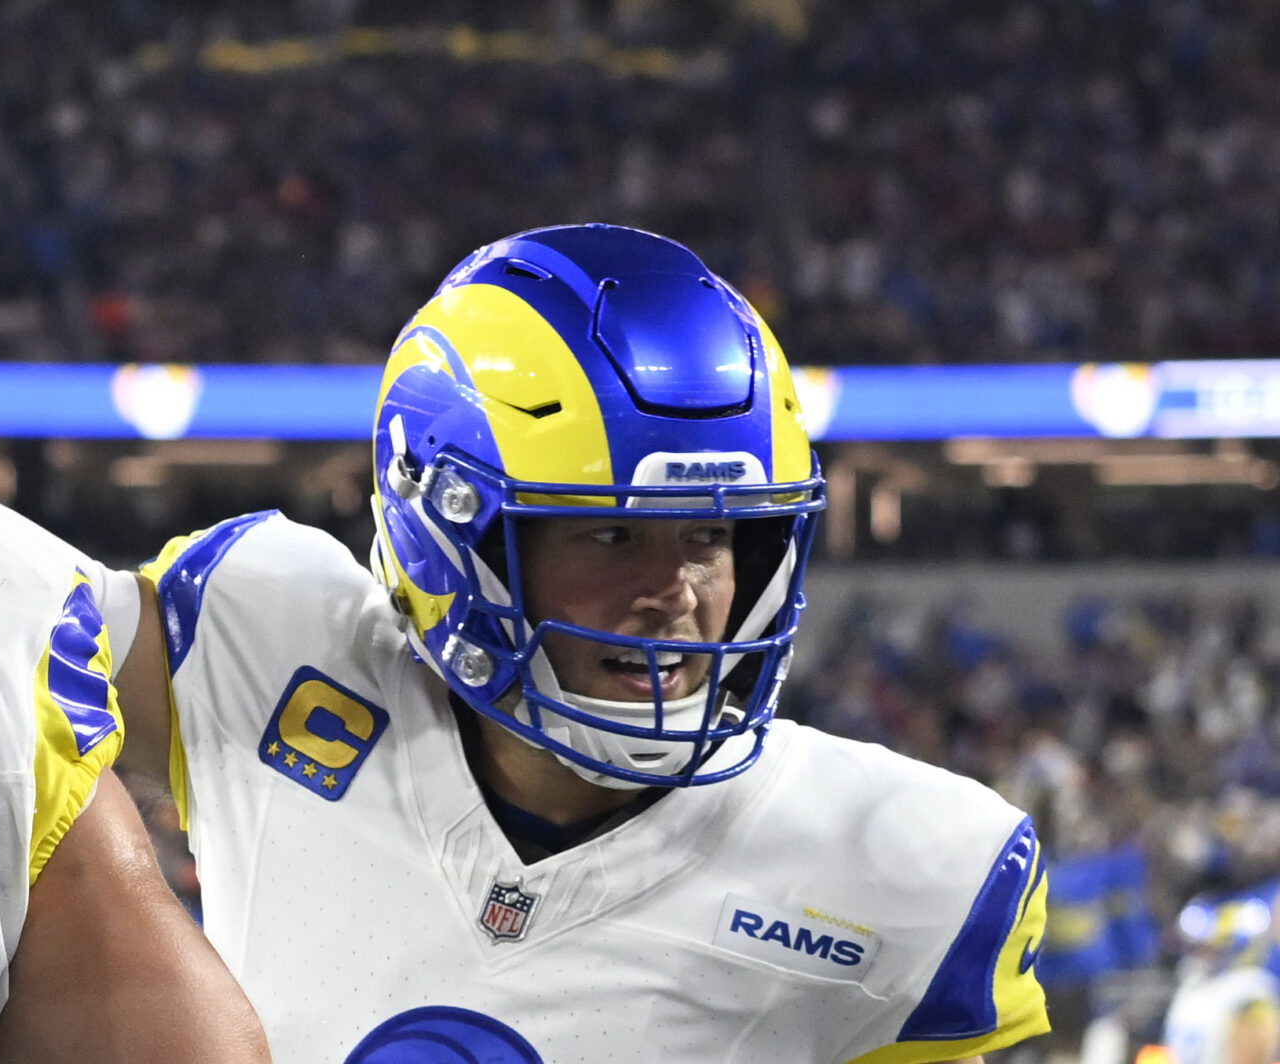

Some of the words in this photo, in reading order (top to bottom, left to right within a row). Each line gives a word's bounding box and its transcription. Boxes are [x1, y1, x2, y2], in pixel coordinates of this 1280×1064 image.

[665, 461, 746, 481] RAMS
[278, 679, 375, 769] C
[485, 903, 520, 934] NFL
[729, 909, 865, 966] RAMS
